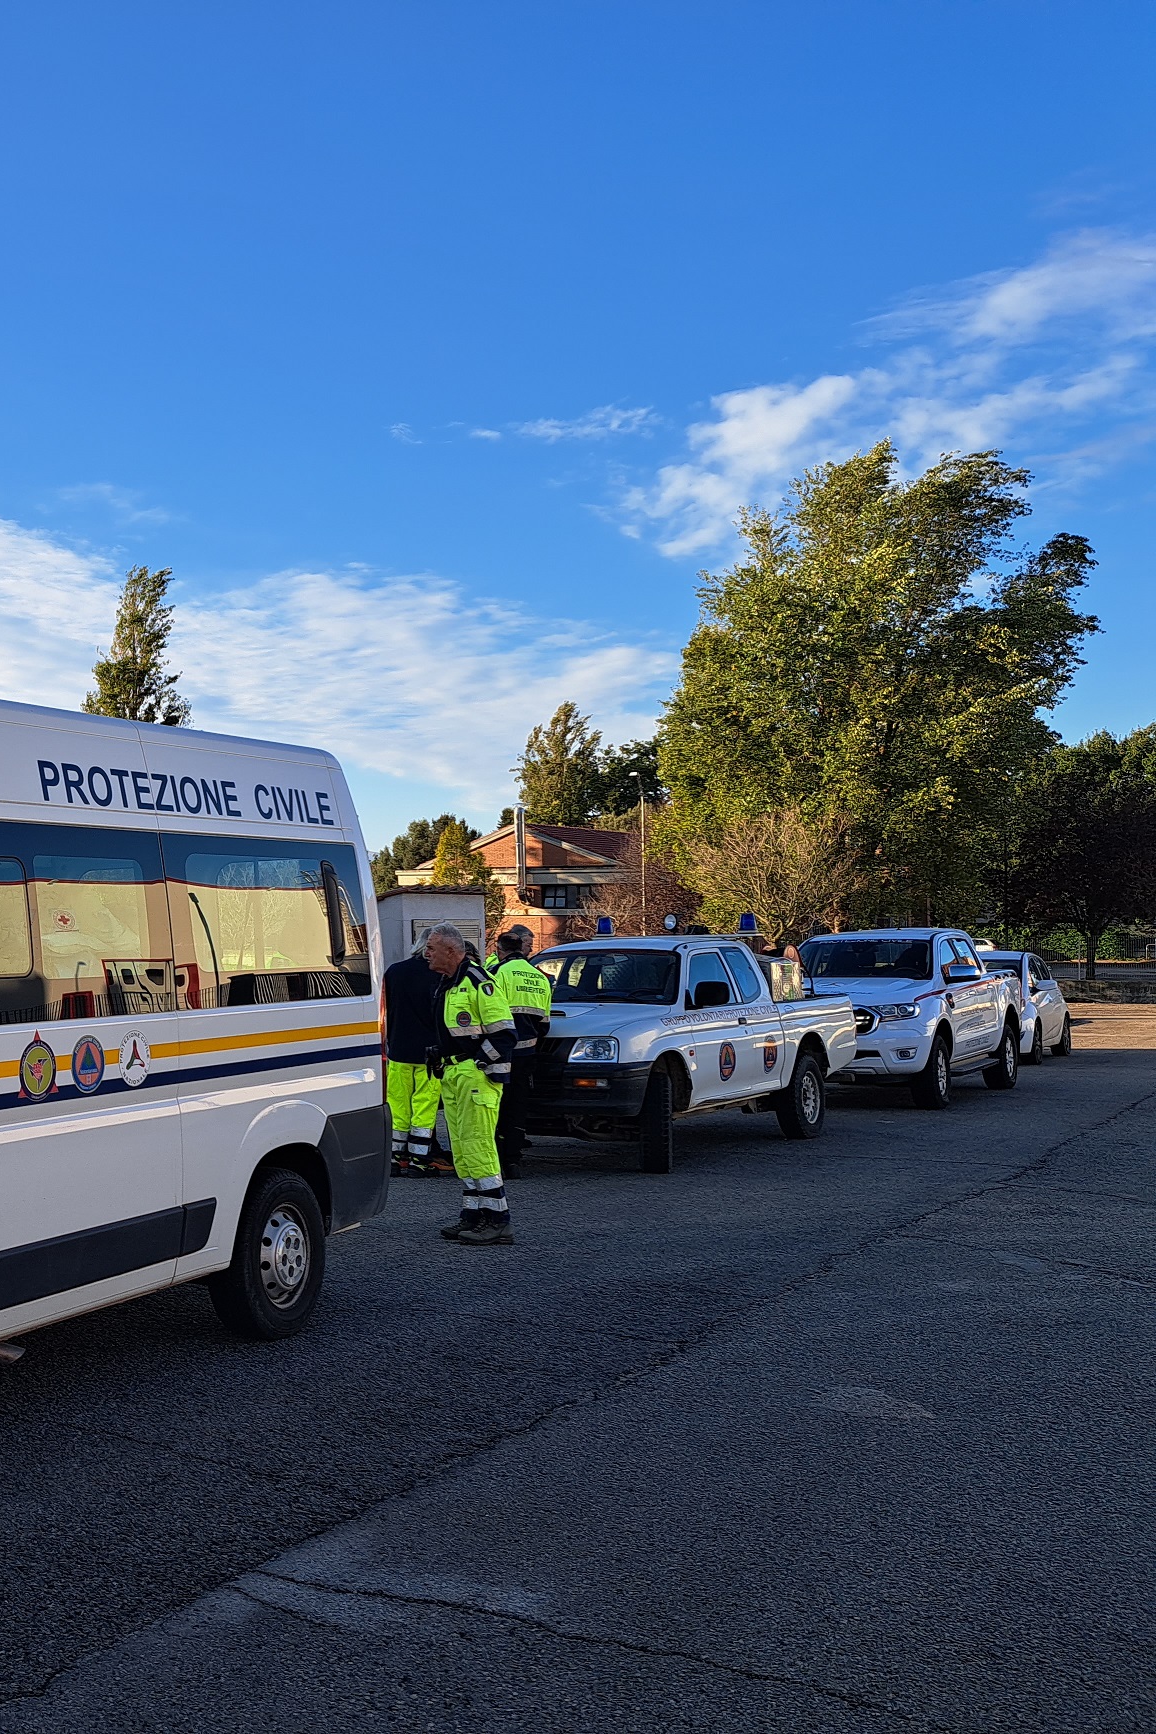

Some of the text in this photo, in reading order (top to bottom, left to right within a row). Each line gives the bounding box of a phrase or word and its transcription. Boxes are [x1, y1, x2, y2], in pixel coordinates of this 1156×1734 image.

[37, 760, 334, 826] PROTEZIONE CIVILE
[660, 1004, 779, 1027] GRUPPO VOLONTARI PROTEZIONE CIVILE
[119, 1032, 150, 1063] PROTEZIONE CIVILE
